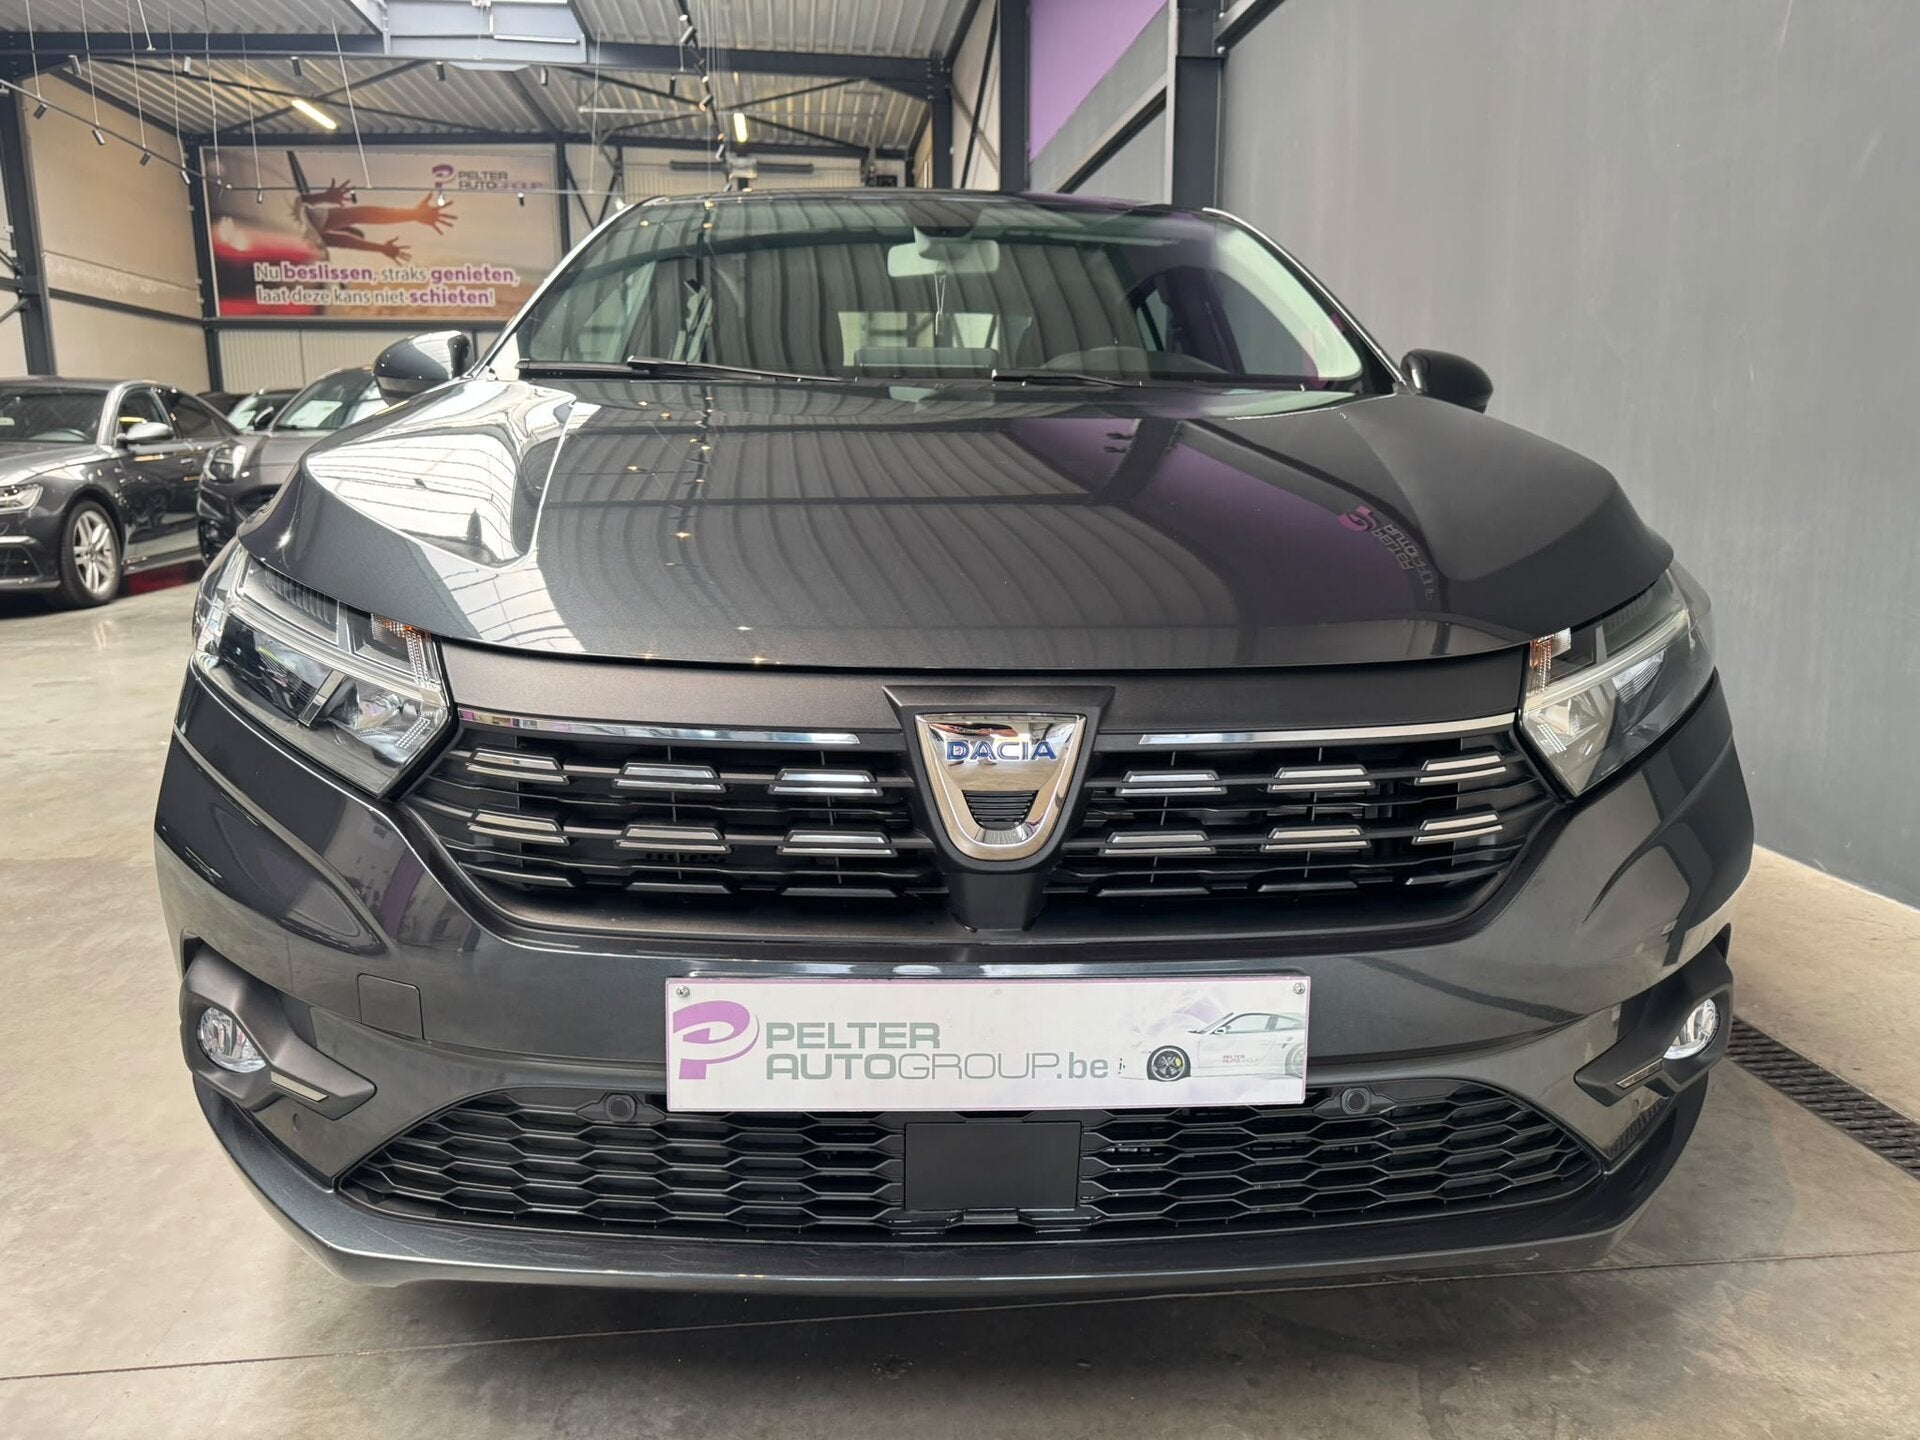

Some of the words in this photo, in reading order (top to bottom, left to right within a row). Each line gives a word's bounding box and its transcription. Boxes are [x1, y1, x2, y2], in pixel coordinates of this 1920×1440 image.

[458, 170, 508, 180] PELTER
[256, 264, 280, 279] Nu
[284, 264, 377, 282] beslissen,
[382, 267, 426, 280] straks
[431, 265, 518, 284] genieten,
[258, 287, 289, 303] laat
[291, 289, 330, 304] deze
[335, 288, 371, 303] kans
[375, 290, 404, 303] niet
[410, 288, 493, 304] schieten!
[946, 741, 1057, 760] DACIA
[766, 1022, 940, 1049] PELTER
[766, 1052, 1108, 1080] AUTOGROUP.be
